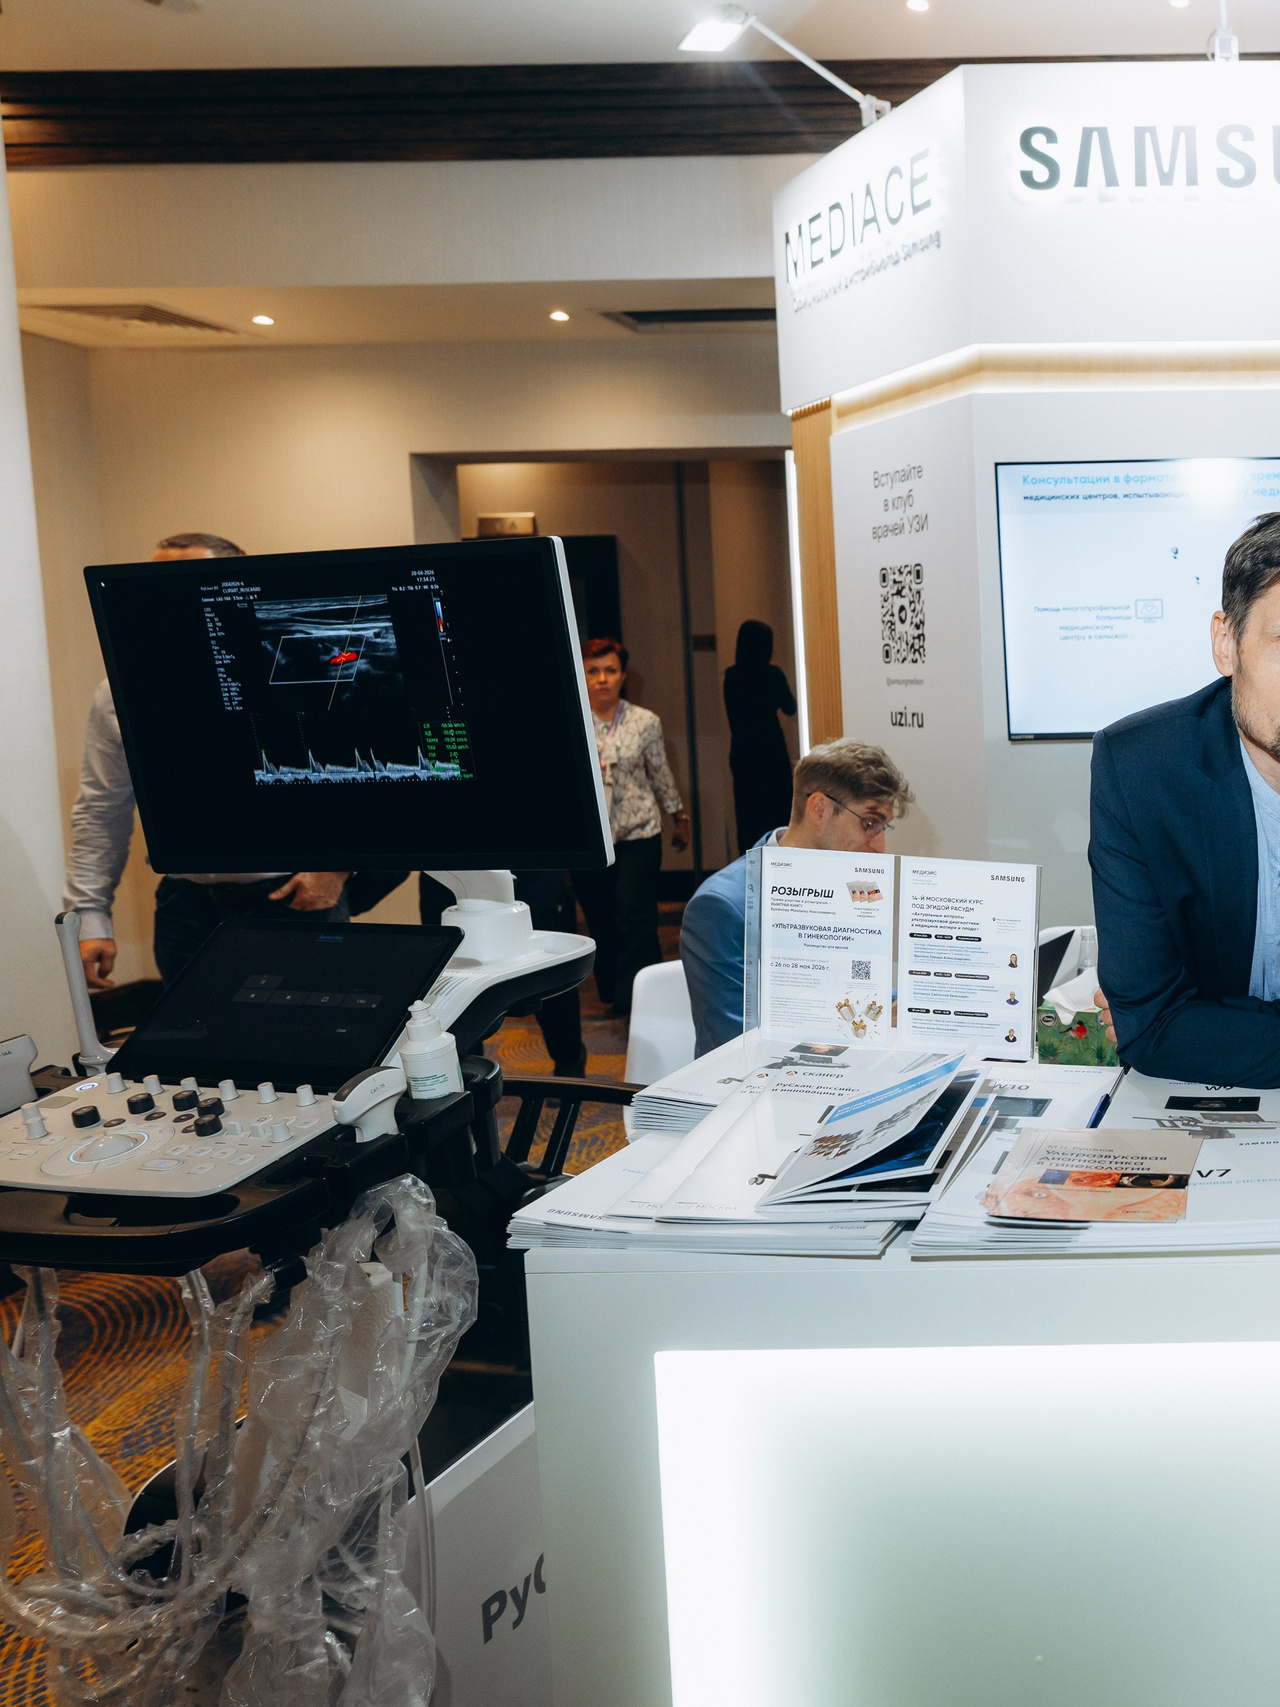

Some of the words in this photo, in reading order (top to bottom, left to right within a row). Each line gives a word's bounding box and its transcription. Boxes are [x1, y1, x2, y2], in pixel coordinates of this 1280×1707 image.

[785, 148, 932, 283] MEDIACE
[873, 464, 924, 490] Вступайте
[1022, 473, 1110, 487] Консультации
[1113, 475, 1120, 484] в
[883, 498, 889, 512] в
[891, 488, 914, 513] клуб
[1023, 493, 1080, 502] медицинских
[872, 517, 905, 543] врачей
[907, 513, 929, 534] УЗИ
[1062, 604, 1131, 612] многопрофильной
[890, 706, 924, 728] uzi.ru
[854, 867, 885, 875] SAMSUNG
[990, 875, 1026, 883] SAMSUNG
[770, 886, 835, 899] РОЗЫГРЫШ
[925, 896, 968, 904] МОСКОВСКИЙ
[771, 922, 832, 932] «УЛЬТРАЗВУКОВАЯ
[832, 926, 883, 936] ДИАГНОСТИКА
[803, 933, 855, 942] ГИНЕКОЛОГИИ»
[802, 1071, 844, 1079] сканер
[780, 1088, 836, 1096] инновации
[994, 1083, 1030, 1091] W10
[1045, 1150, 1168, 1161] Ультразвуковая
[1048, 1162, 1151, 1171] гинекологии
[1196, 1168, 1232, 1178] V7
[546, 1208, 605, 1220] SAMSUNG
